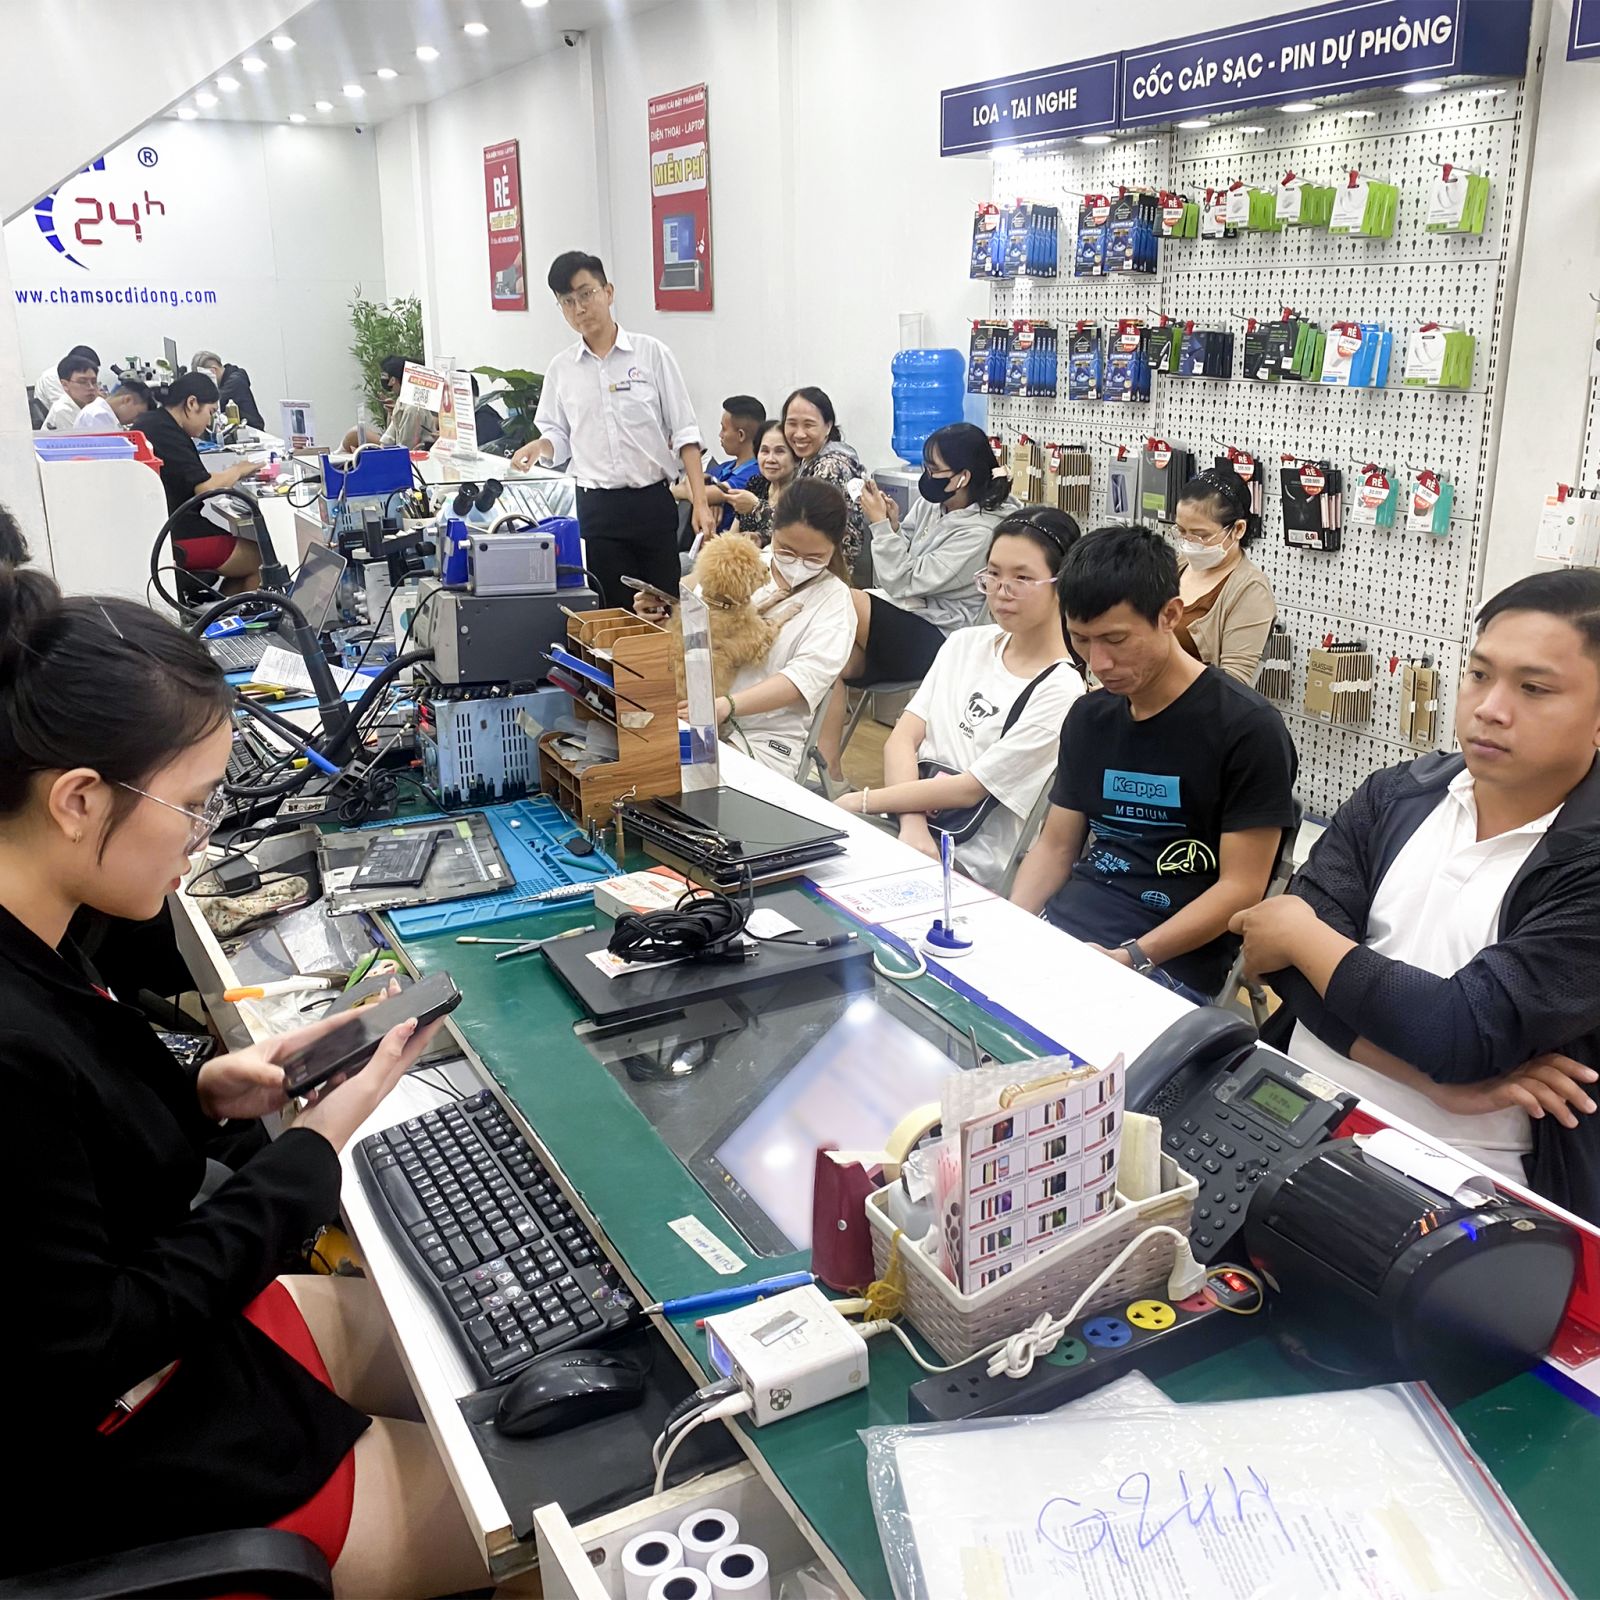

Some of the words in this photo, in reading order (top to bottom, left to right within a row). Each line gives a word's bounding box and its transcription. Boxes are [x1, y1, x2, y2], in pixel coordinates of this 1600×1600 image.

[1133, 62, 1174, 100] CỐC
[1178, 57, 1218, 91] CÁP
[1222, 52, 1263, 88] SẠC
[1280, 41, 1316, 73] PIN
[1322, 28, 1356, 69] DỰ
[1360, 15, 1452, 58] PHÒNG
[973, 104, 1000, 127] LOA
[1011, 96, 1031, 119] TAI
[1035, 88, 1078, 115] NGHE
[650, 127, 664, 143] ĐIỆN
[664, 124, 682, 139] THOẠI
[684, 118, 705, 135] LAPTOP
[654, 152, 683, 186] MIỄN
[684, 148, 705, 182] PHÍ
[493, 164, 511, 208] RẺ
[1168, 197, 1178, 208] RẺ
[1347, 326, 1358, 337] RẺ
[1305, 466, 1317, 476] RẺ
[1371, 475, 1384, 488] RẺ
[1425, 475, 1437, 492] RẺ
[1113, 776, 1168, 798] Kappa
[1115, 805, 1169, 820] MEDIUM
